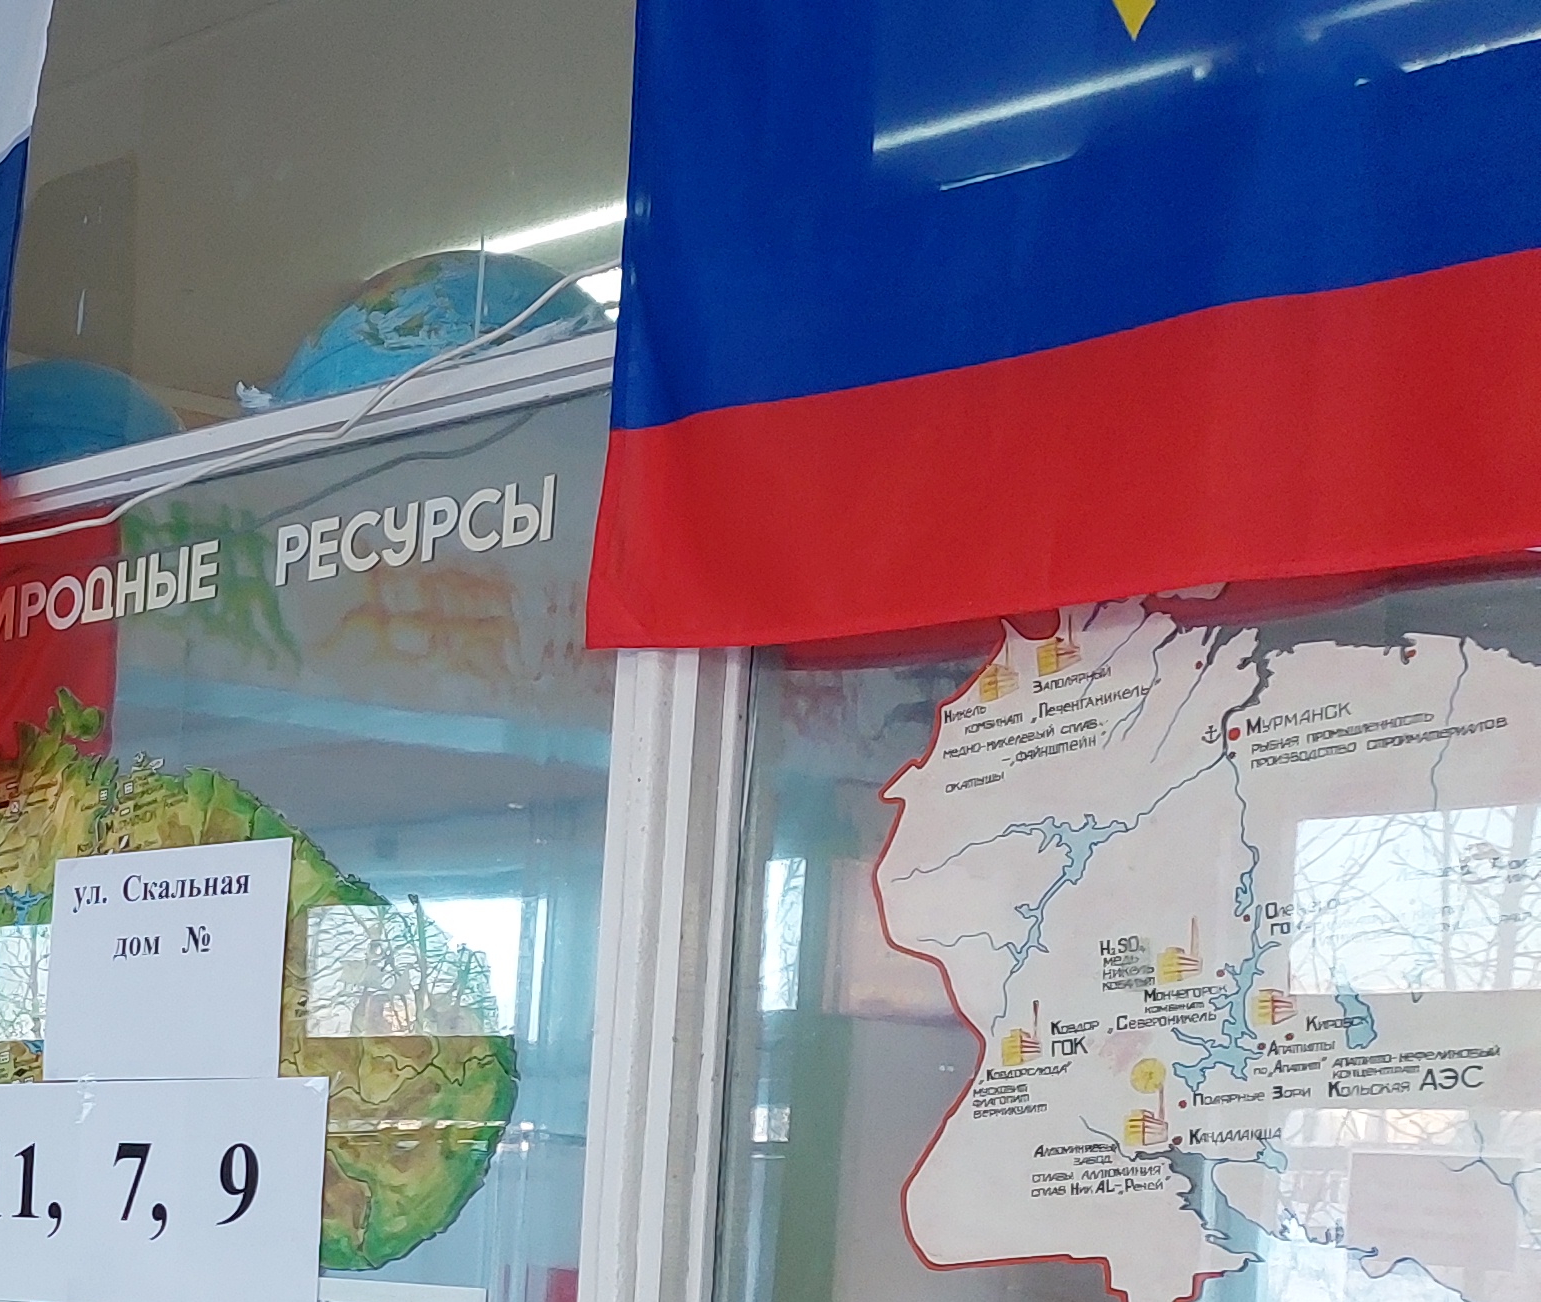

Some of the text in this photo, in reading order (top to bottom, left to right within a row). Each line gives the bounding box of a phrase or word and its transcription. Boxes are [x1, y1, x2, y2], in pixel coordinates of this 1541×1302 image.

[275, 474, 557, 587] РЕСУРСЫ
[72, 873, 251, 912] ул. Скальная
[113, 925, 212, 961] дом №
[1050, 1036, 1089, 1057] ГОК
[1419, 1064, 1485, 1093] АЭС
[113, 1142, 169, 1241] 7,
[215, 1142, 260, 1227] 9
